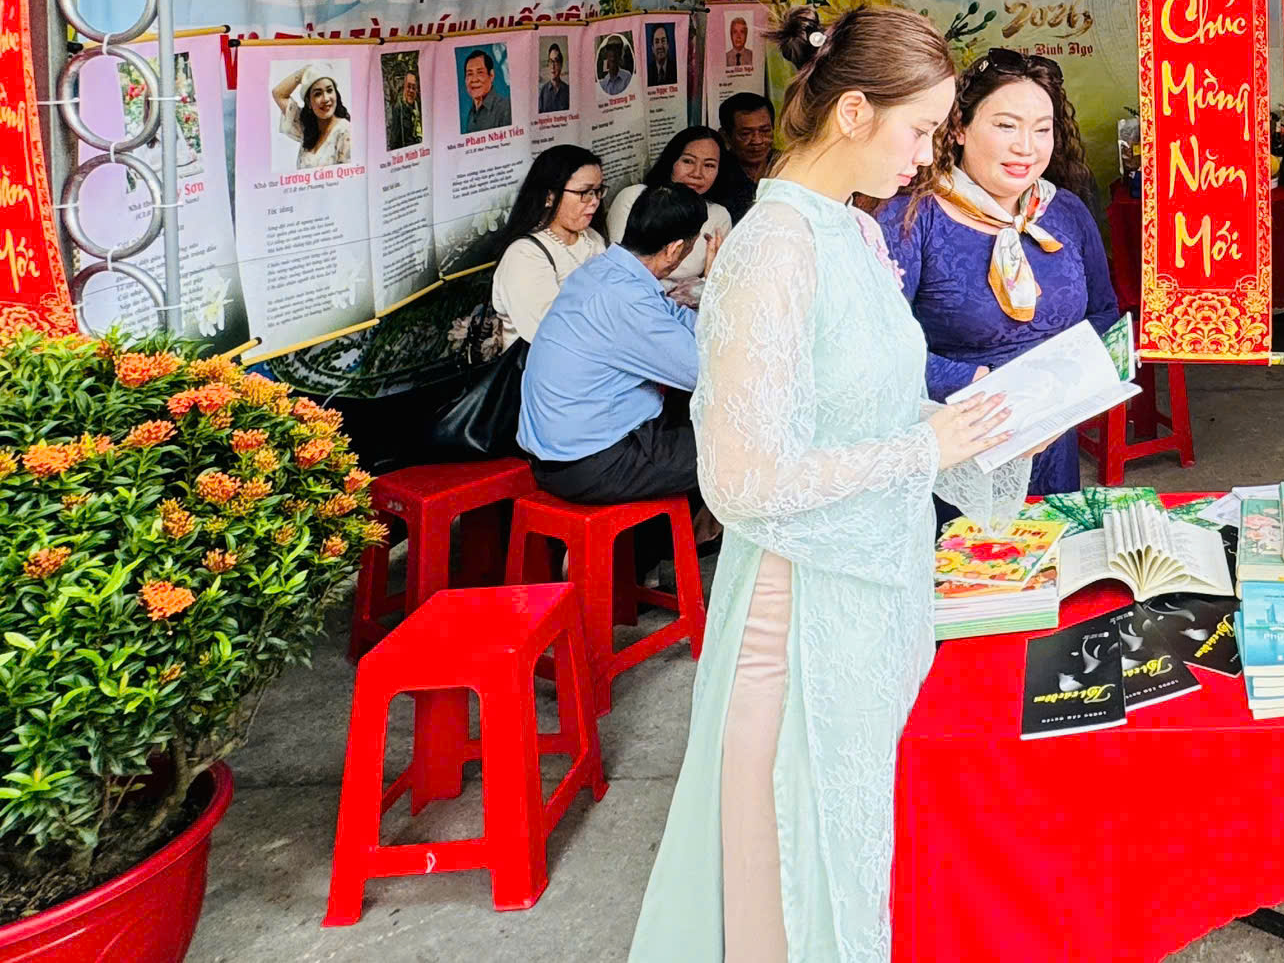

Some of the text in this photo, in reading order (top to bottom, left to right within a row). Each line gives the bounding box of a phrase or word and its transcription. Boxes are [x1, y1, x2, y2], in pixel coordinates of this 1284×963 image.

[1161, 59, 1251, 141] Mừng
[465, 135, 486, 147] Phan
[489, 132, 507, 143] Nhật
[280, 172, 311, 186] Lương
[1168, 139, 1249, 200] Năm
[184, 181, 205, 197] Sơn
[1174, 211, 1244, 278] Mới
